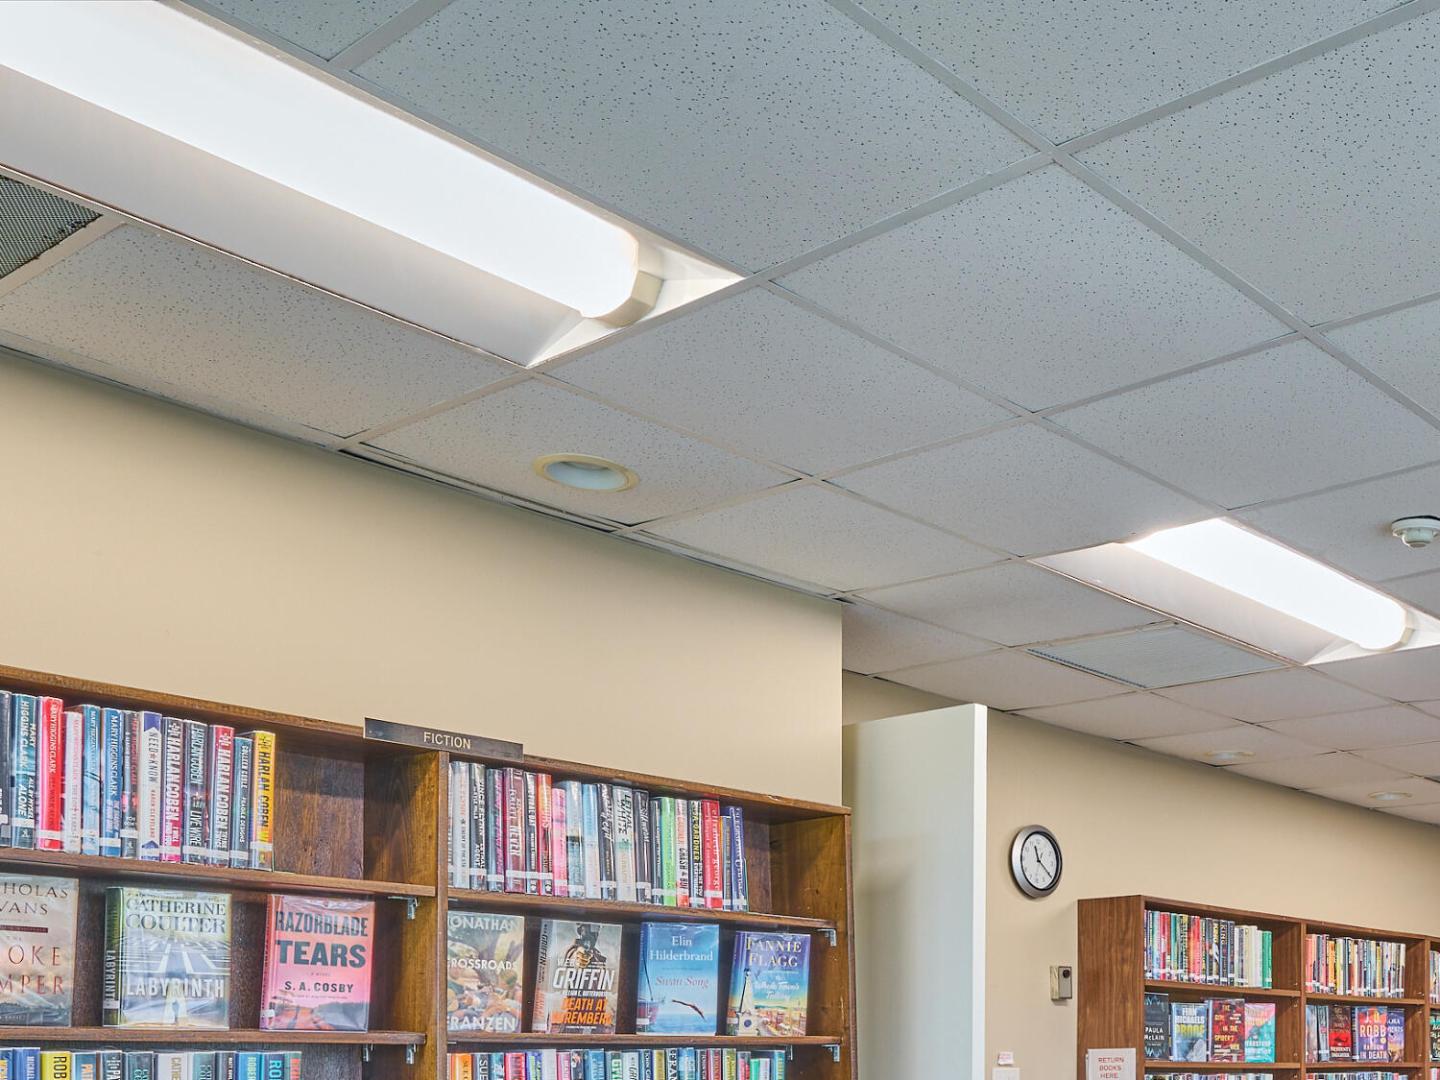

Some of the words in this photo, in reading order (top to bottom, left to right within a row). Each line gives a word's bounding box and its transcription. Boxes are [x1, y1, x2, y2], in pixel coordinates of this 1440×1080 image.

[423, 731, 471, 749] FICTION
[126, 898, 226, 916] CATHERINE
[126, 914, 226, 934] COULTER
[275, 910, 369, 937] RAZORBLADE
[449, 915, 520, 932] ONATHAN
[539, 934, 549, 967] GRIFFIN
[672, 936, 692, 947] Elin
[746, 937, 802, 952] FANNIE
[276, 939, 366, 969] TEARS
[650, 950, 713, 961] Hilderbrand
[749, 953, 798, 967] FLAGG
[104, 950, 116, 1000] LABYRINT
[553, 968, 616, 990] GRIFFIN
[127, 977, 225, 998] LABYRINTH
[299, 981, 311, 992] A.
[313, 982, 354, 993] COSBY
[562, 997, 594, 1011] DEATH
[595, 998, 607, 1010] AT
[1144, 1026, 1164, 1034] PAULA
[1360, 1025, 1387, 1038] ROBB
[480, 1059, 489, 1080] SUE
